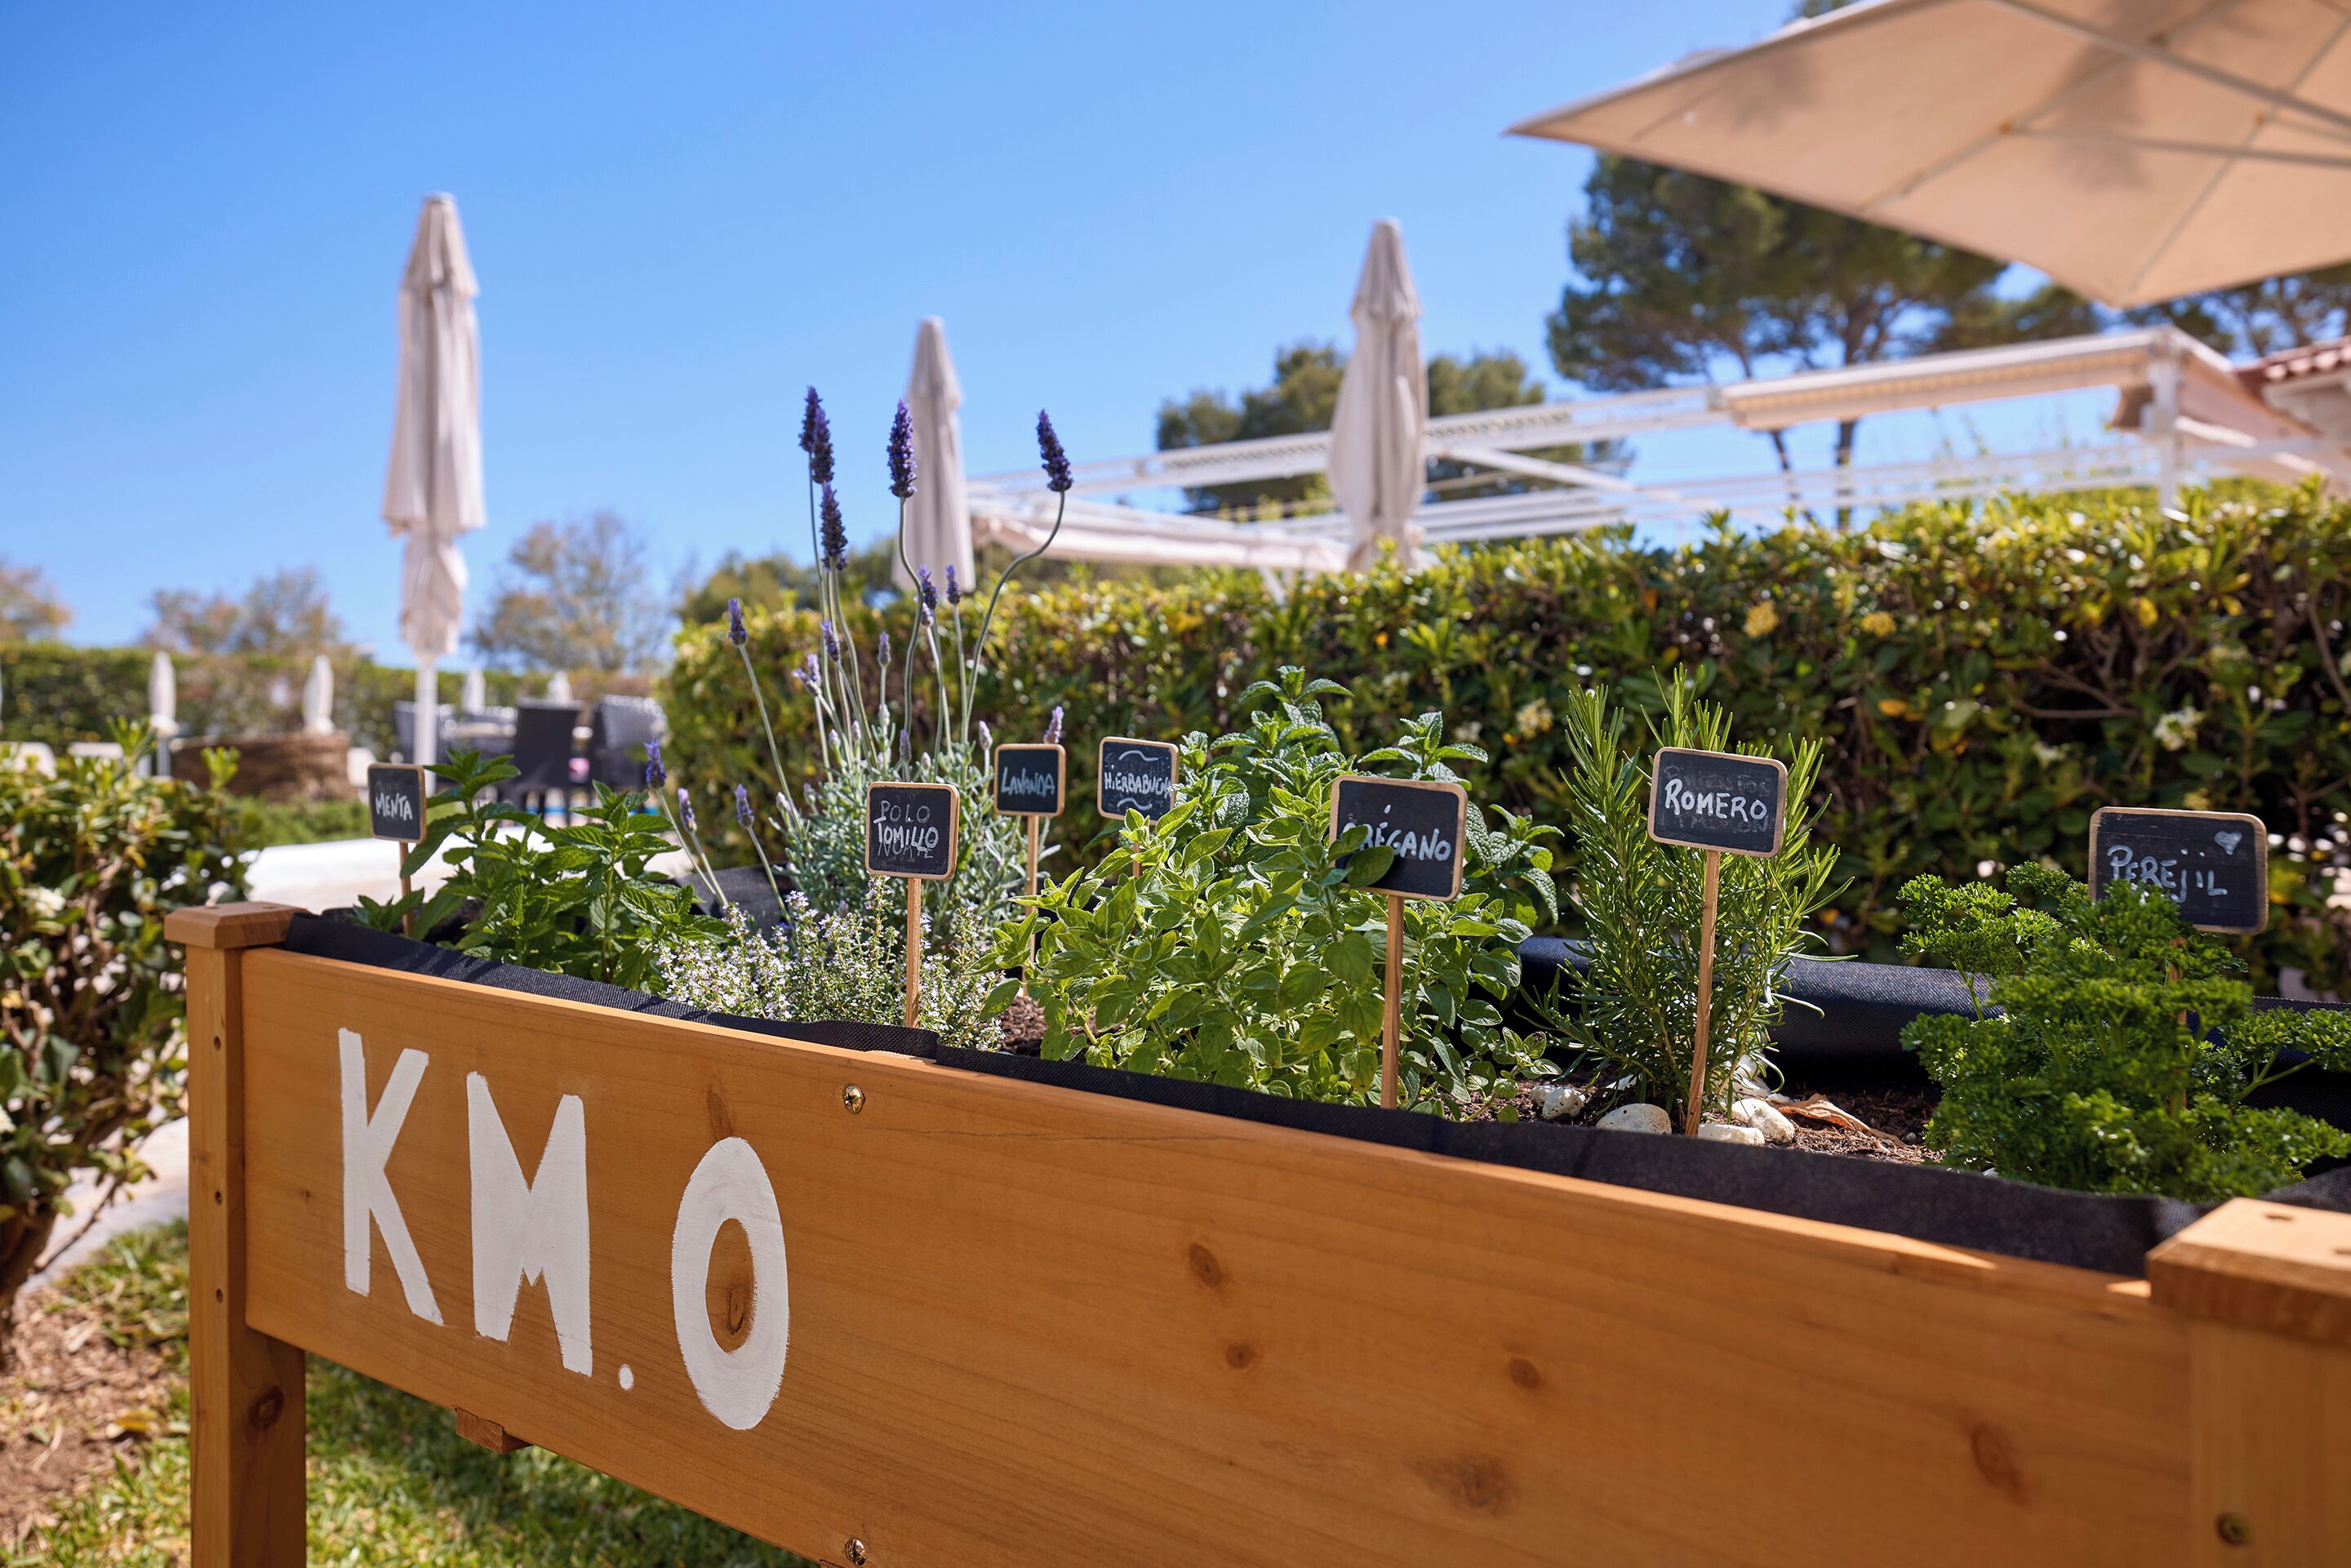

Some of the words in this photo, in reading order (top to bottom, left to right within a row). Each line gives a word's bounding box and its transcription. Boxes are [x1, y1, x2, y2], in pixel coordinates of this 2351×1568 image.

[1001, 766, 1056, 797] LAVANDA
[375, 793, 413, 821] MENTA
[879, 800, 931, 824] POLO
[1664, 778, 1767, 823] ROMERO
[873, 816, 940, 851] TOMILLO
